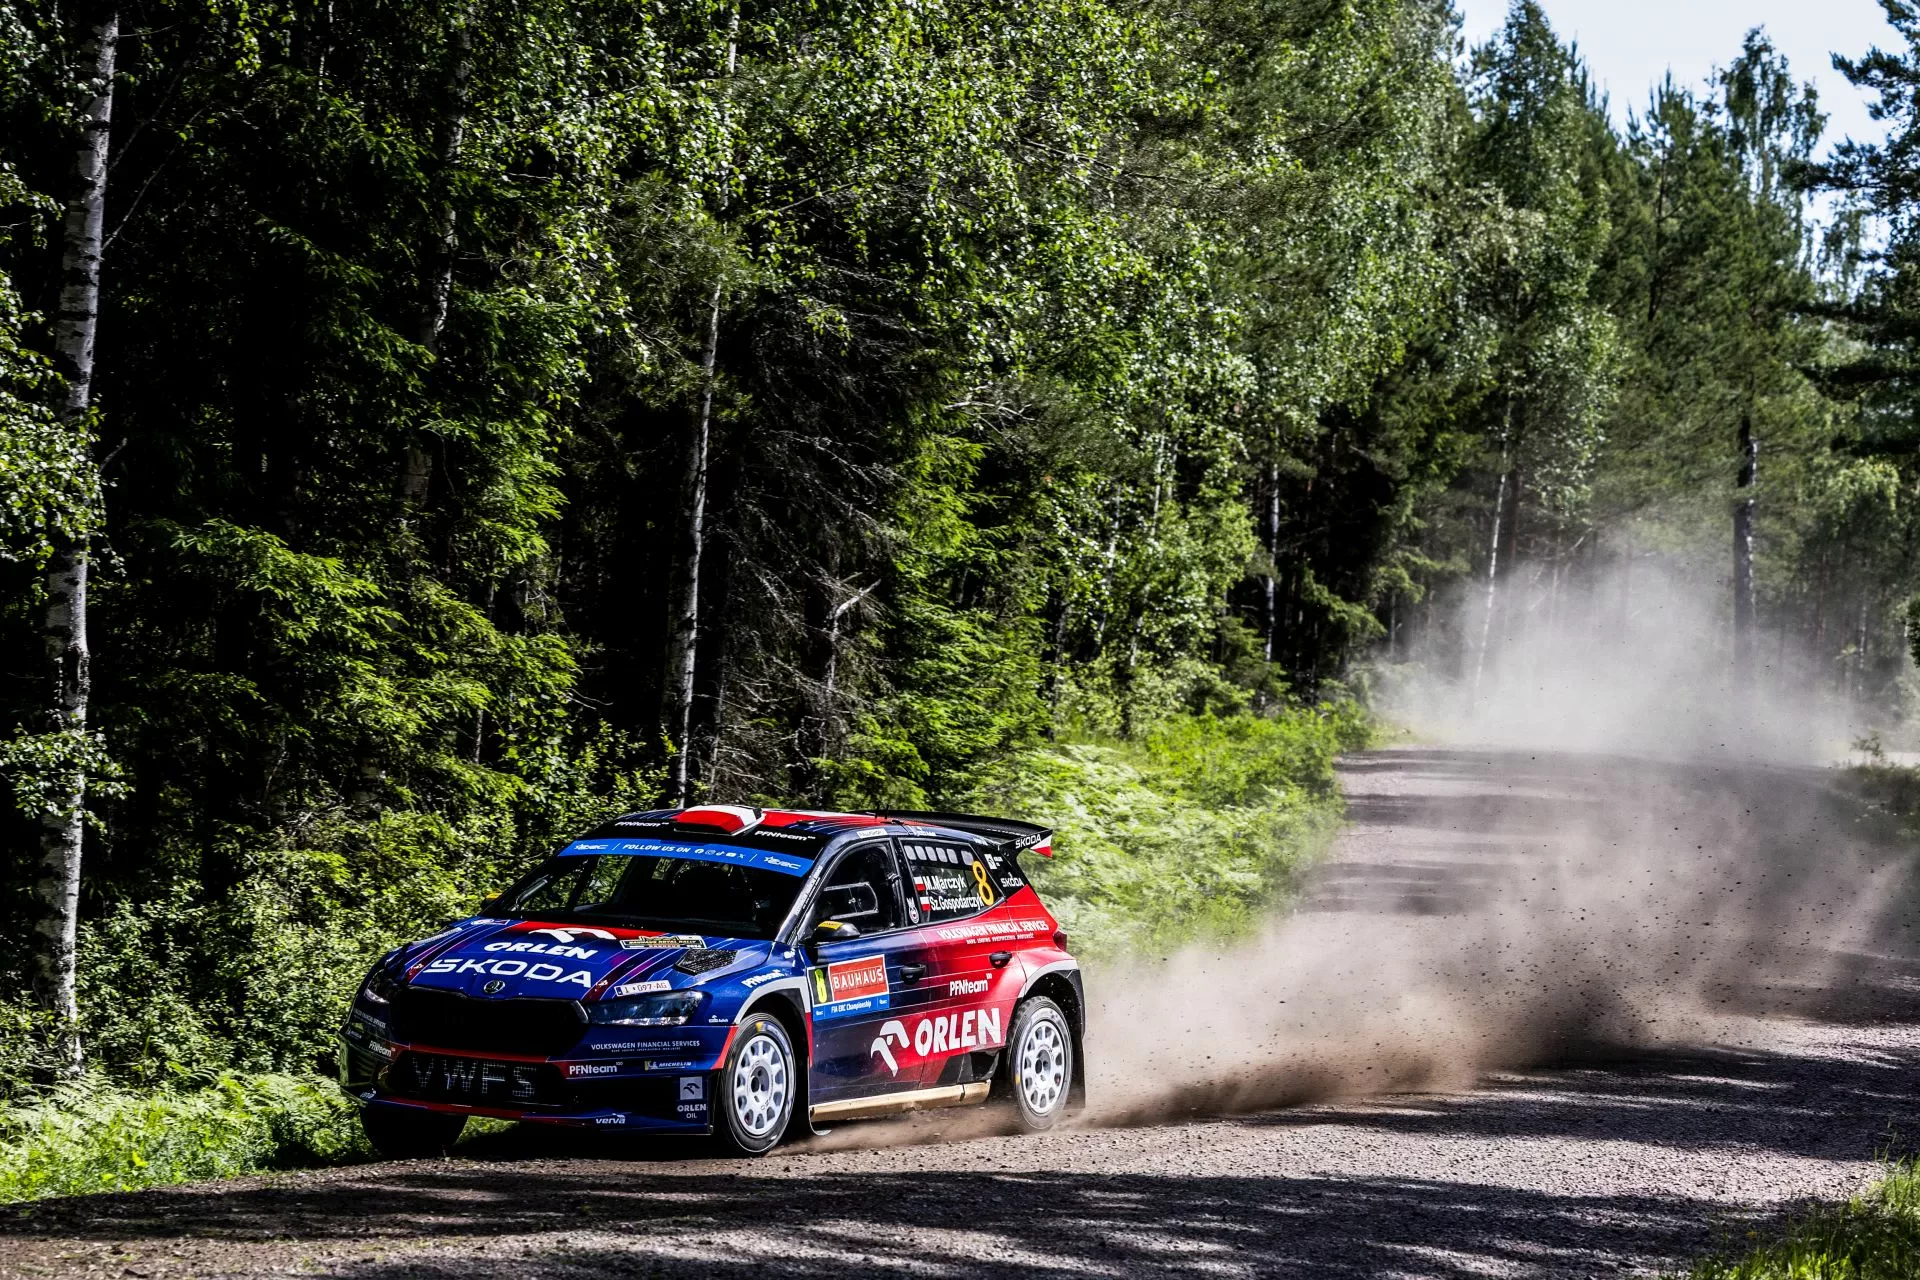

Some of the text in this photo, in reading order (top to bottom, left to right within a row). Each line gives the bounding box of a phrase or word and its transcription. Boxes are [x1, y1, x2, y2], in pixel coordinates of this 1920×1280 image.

[754, 830, 808, 841] PFNteam
[922, 874, 967, 893] M.Marczyk
[972, 860, 995, 907] 8
[1018, 920, 1050, 932] SERVICES
[483, 942, 599, 960] ORLEN
[833, 968, 884, 990] BAUHAUS
[949, 979, 989, 997] PFNteam
[914, 1007, 1002, 1057] ORLEN
[591, 1042, 636, 1051] VOLKSWAGEN
[637, 1040, 671, 1049] FINANCIAL
[672, 1040, 701, 1048] SERVICES
[569, 1064, 618, 1075] PFNteam
[676, 1103, 707, 1113] ORLEN
